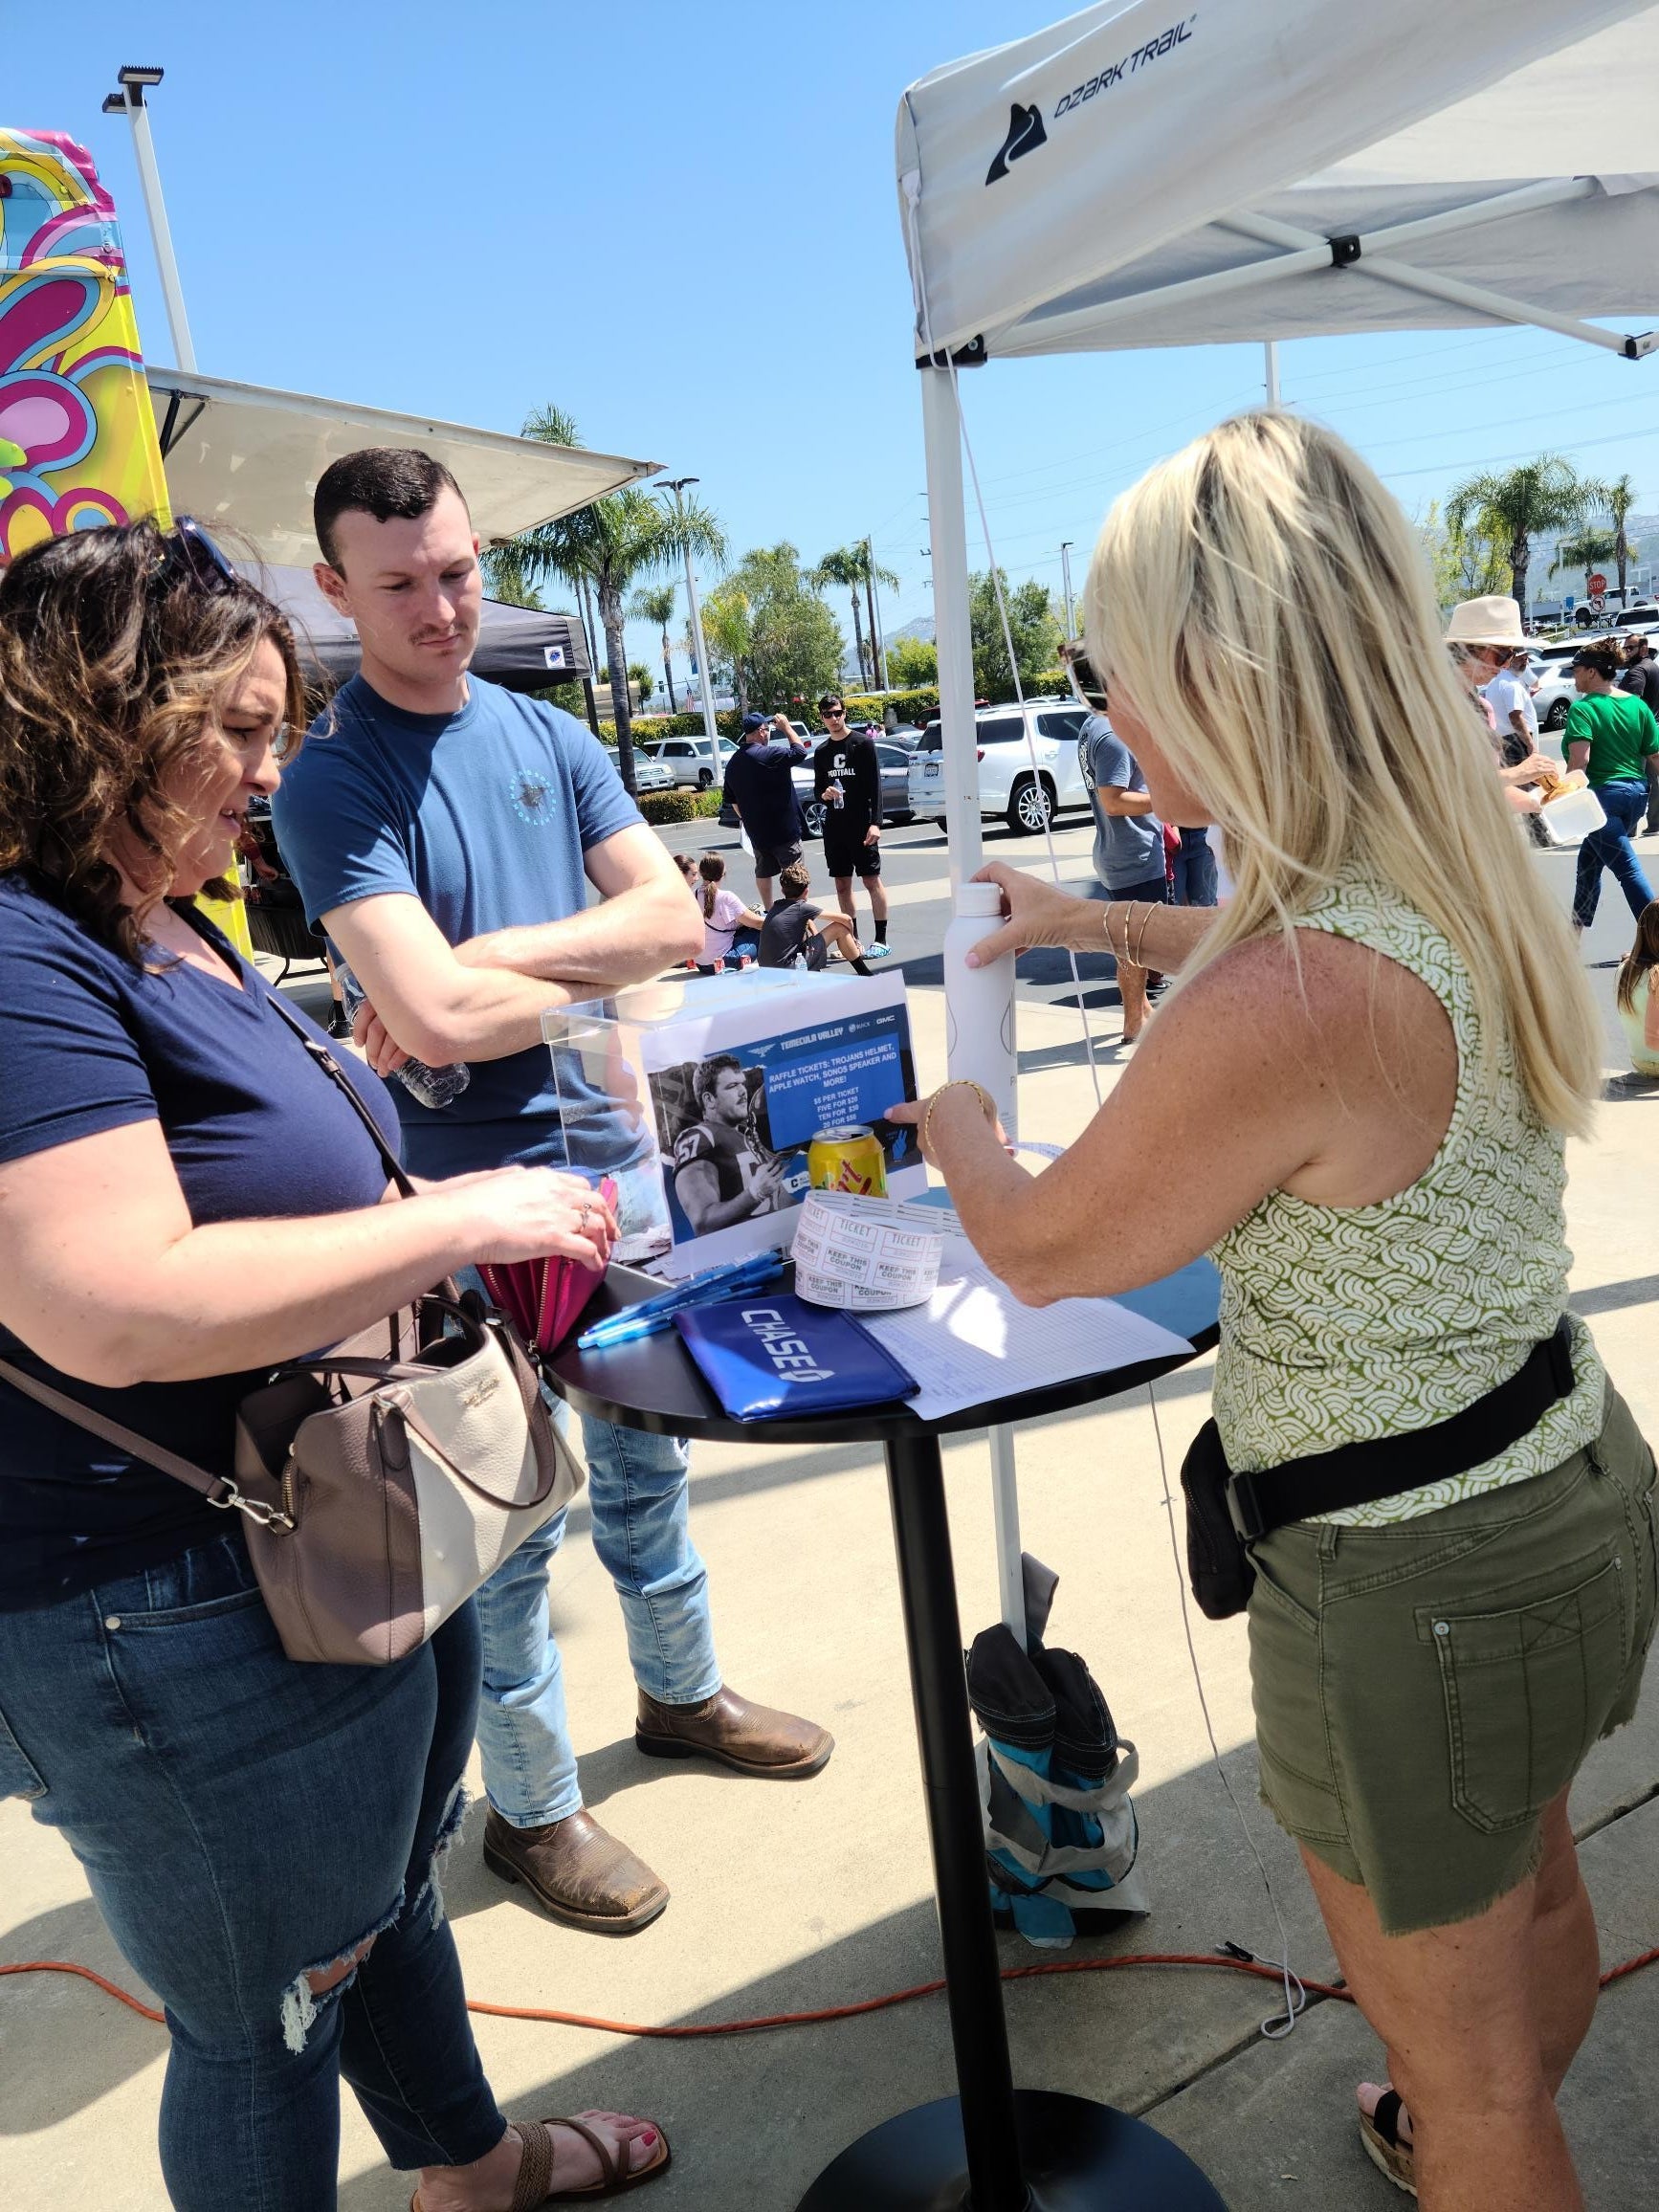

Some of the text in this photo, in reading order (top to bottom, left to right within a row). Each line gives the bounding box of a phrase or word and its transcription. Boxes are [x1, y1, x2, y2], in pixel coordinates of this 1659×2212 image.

[1589, 580, 1606, 590] STOP
[833, 753, 847, 769] C
[828, 767, 856, 778] FOOTBALL
[876, 1015, 896, 1025] GMC
[817, 1027, 843, 1042] VALLEY
[769, 1043, 895, 1083] RAFFLE TICKETS: TROJANS HELMET,
[769, 1052, 896, 1094] APPLE WATCH, SONOS SPEAKER AND
[824, 1076, 847, 1088] MORE!
[822, 1093, 836, 1103] PER
[837, 1087, 859, 1099] TICKET
[817, 1095, 858, 1113] FIVE FOR $20
[818, 1113, 831, 1121] TEN
[832, 1108, 846, 1118] FOR
[831, 1117, 846, 1126] FOR
[678, 1133, 700, 1164] 57
[839, 1218, 871, 1237] TICKET
[892, 1232, 921, 1247] TICKET
[828, 1247, 868, 1267] KEEP THIS
[830, 1256, 862, 1272] COUPON
[879, 1264, 900, 1273] KEEP
[881, 1272, 912, 1281] COUPON
[810, 1283, 838, 1294] COUPON
[741, 1308, 818, 1370] CHASE
